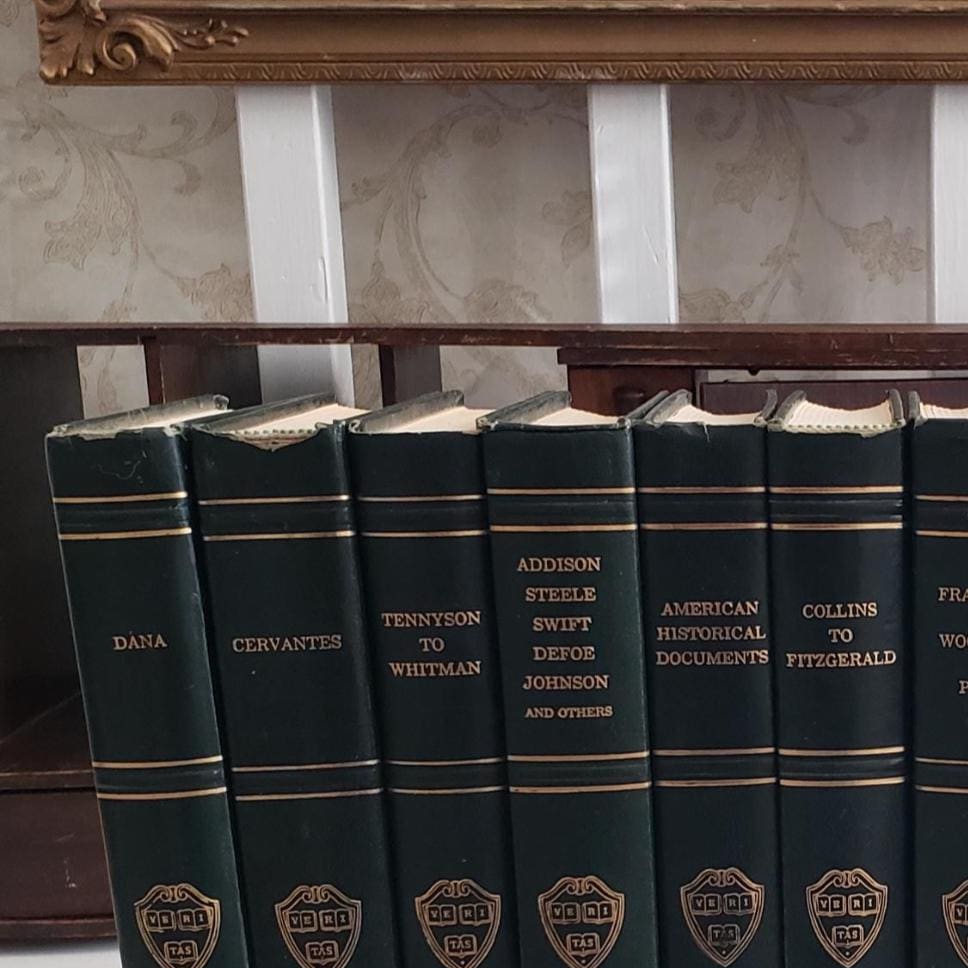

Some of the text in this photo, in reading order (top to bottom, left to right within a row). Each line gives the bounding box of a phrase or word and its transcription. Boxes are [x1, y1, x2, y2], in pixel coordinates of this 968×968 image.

[517, 556, 601, 572] ADDISON
[525, 587, 597, 602] STEELE
[660, 601, 759, 617] AMERICAN
[802, 602, 878, 619] COLLINS
[381, 610, 481, 628] TENNYSON
[532, 616, 592, 632] SWIFT
[656, 626, 766, 641] HISTORICAL
[828, 628, 854, 643] TO
[112, 633, 168, 651] DANA
[232, 635, 342, 653] CERVANTES
[418, 637, 445, 653] TO
[533, 646, 595, 661] DEFOE
[655, 649, 769, 665] DOCUMENTS
[785, 650, 897, 668] FITZGERALD
[389, 661, 481, 677] WHITMAN
[522, 674, 610, 690] JOHNSON
[524, 705, 614, 719] AND OTHERS
